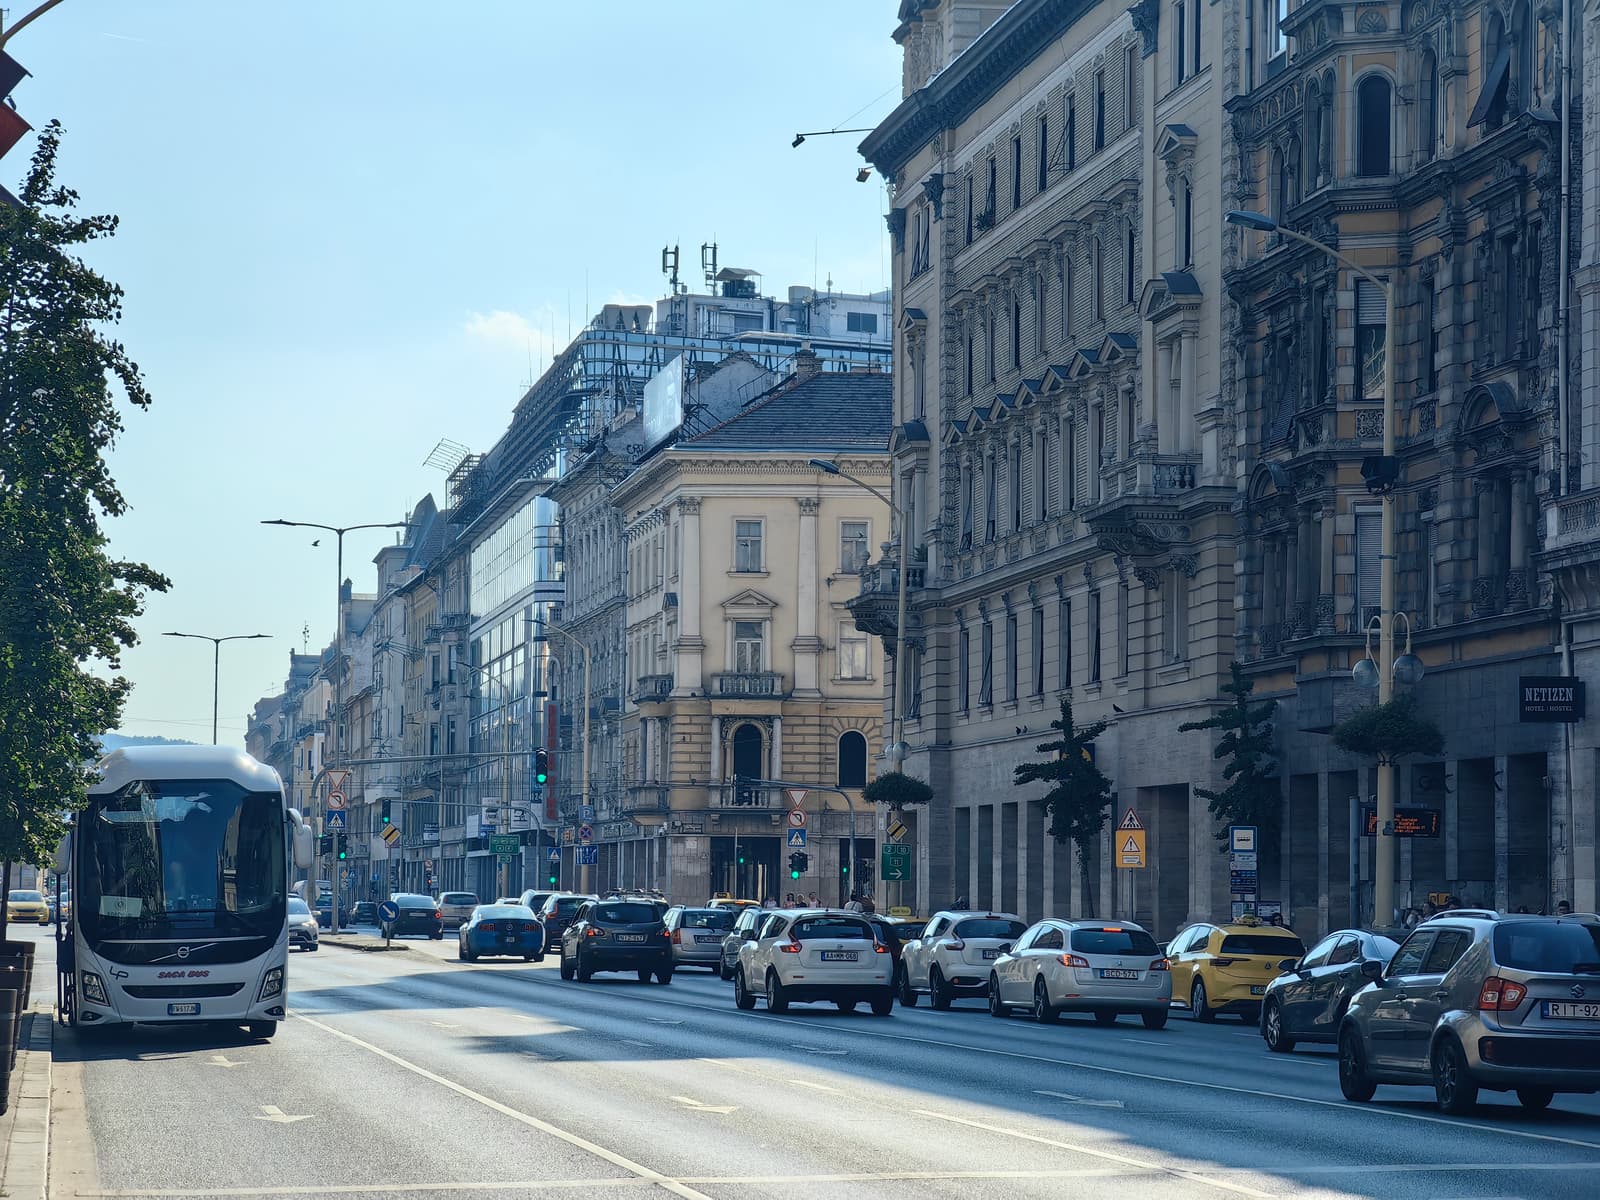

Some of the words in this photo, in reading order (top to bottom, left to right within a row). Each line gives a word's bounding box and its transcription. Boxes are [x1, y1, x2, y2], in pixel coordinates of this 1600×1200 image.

[1525, 687, 1574, 701] NETIZEN
[187, 970, 210, 978] BUS
[1551, 1003, 1600, 1017] RIT-92
